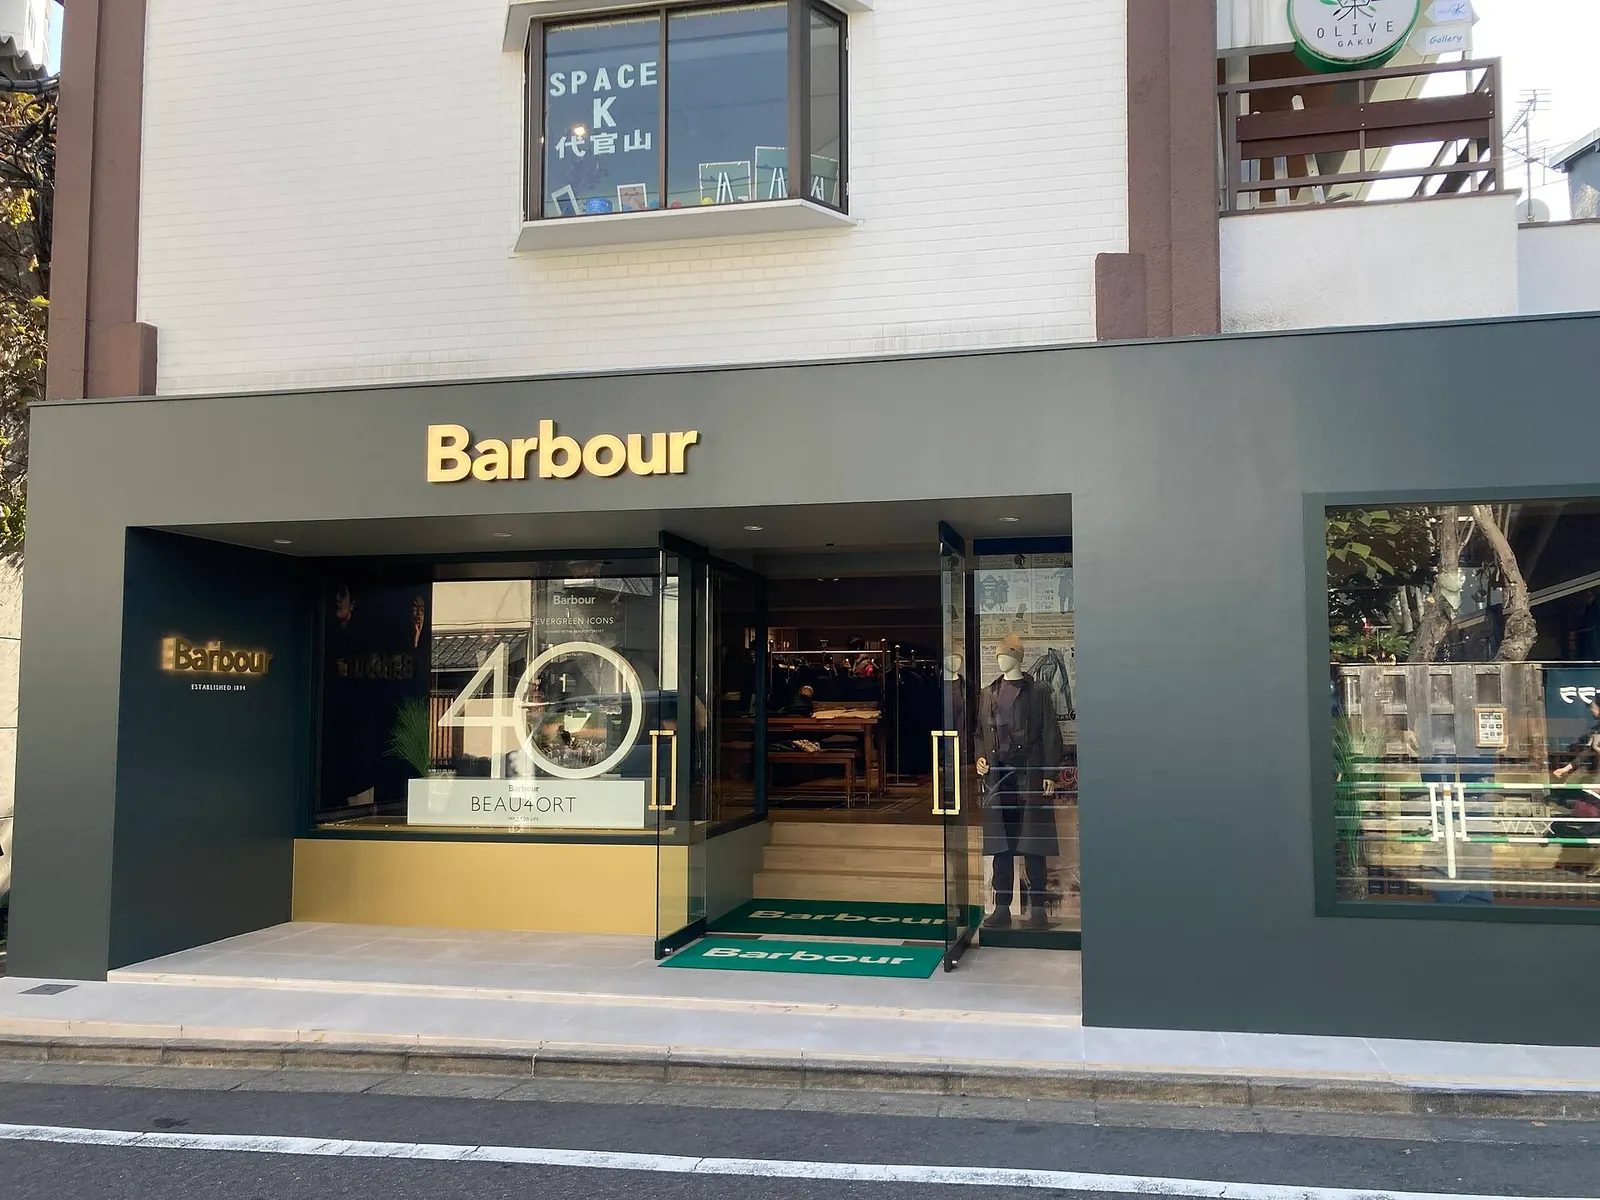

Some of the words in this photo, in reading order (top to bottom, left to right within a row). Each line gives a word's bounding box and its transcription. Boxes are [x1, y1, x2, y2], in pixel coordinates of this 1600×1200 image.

[1316, 20, 1394, 39] OLIVE
[1337, 38, 1373, 48] GAKU
[1429, 34, 1463, 45] Gallery
[549, 61, 658, 97] SPACE
[593, 96, 617, 129] K
[555, 129, 652, 159] 代官山
[427, 419, 698, 483] Barbour
[553, 594, 596, 605] Barbour
[535, 617, 584, 626] EVERGREEN
[587, 616, 614, 625] ICONS
[163, 638, 272, 675] Barbour
[437, 642, 645, 780] 40
[508, 784, 540, 792] Barbour
[471, 796, 577, 813] BEAU4ORT
[1501, 820, 1556, 835] WAX
[748, 909, 946, 926] Barbour
[702, 947, 914, 965] Barbour
